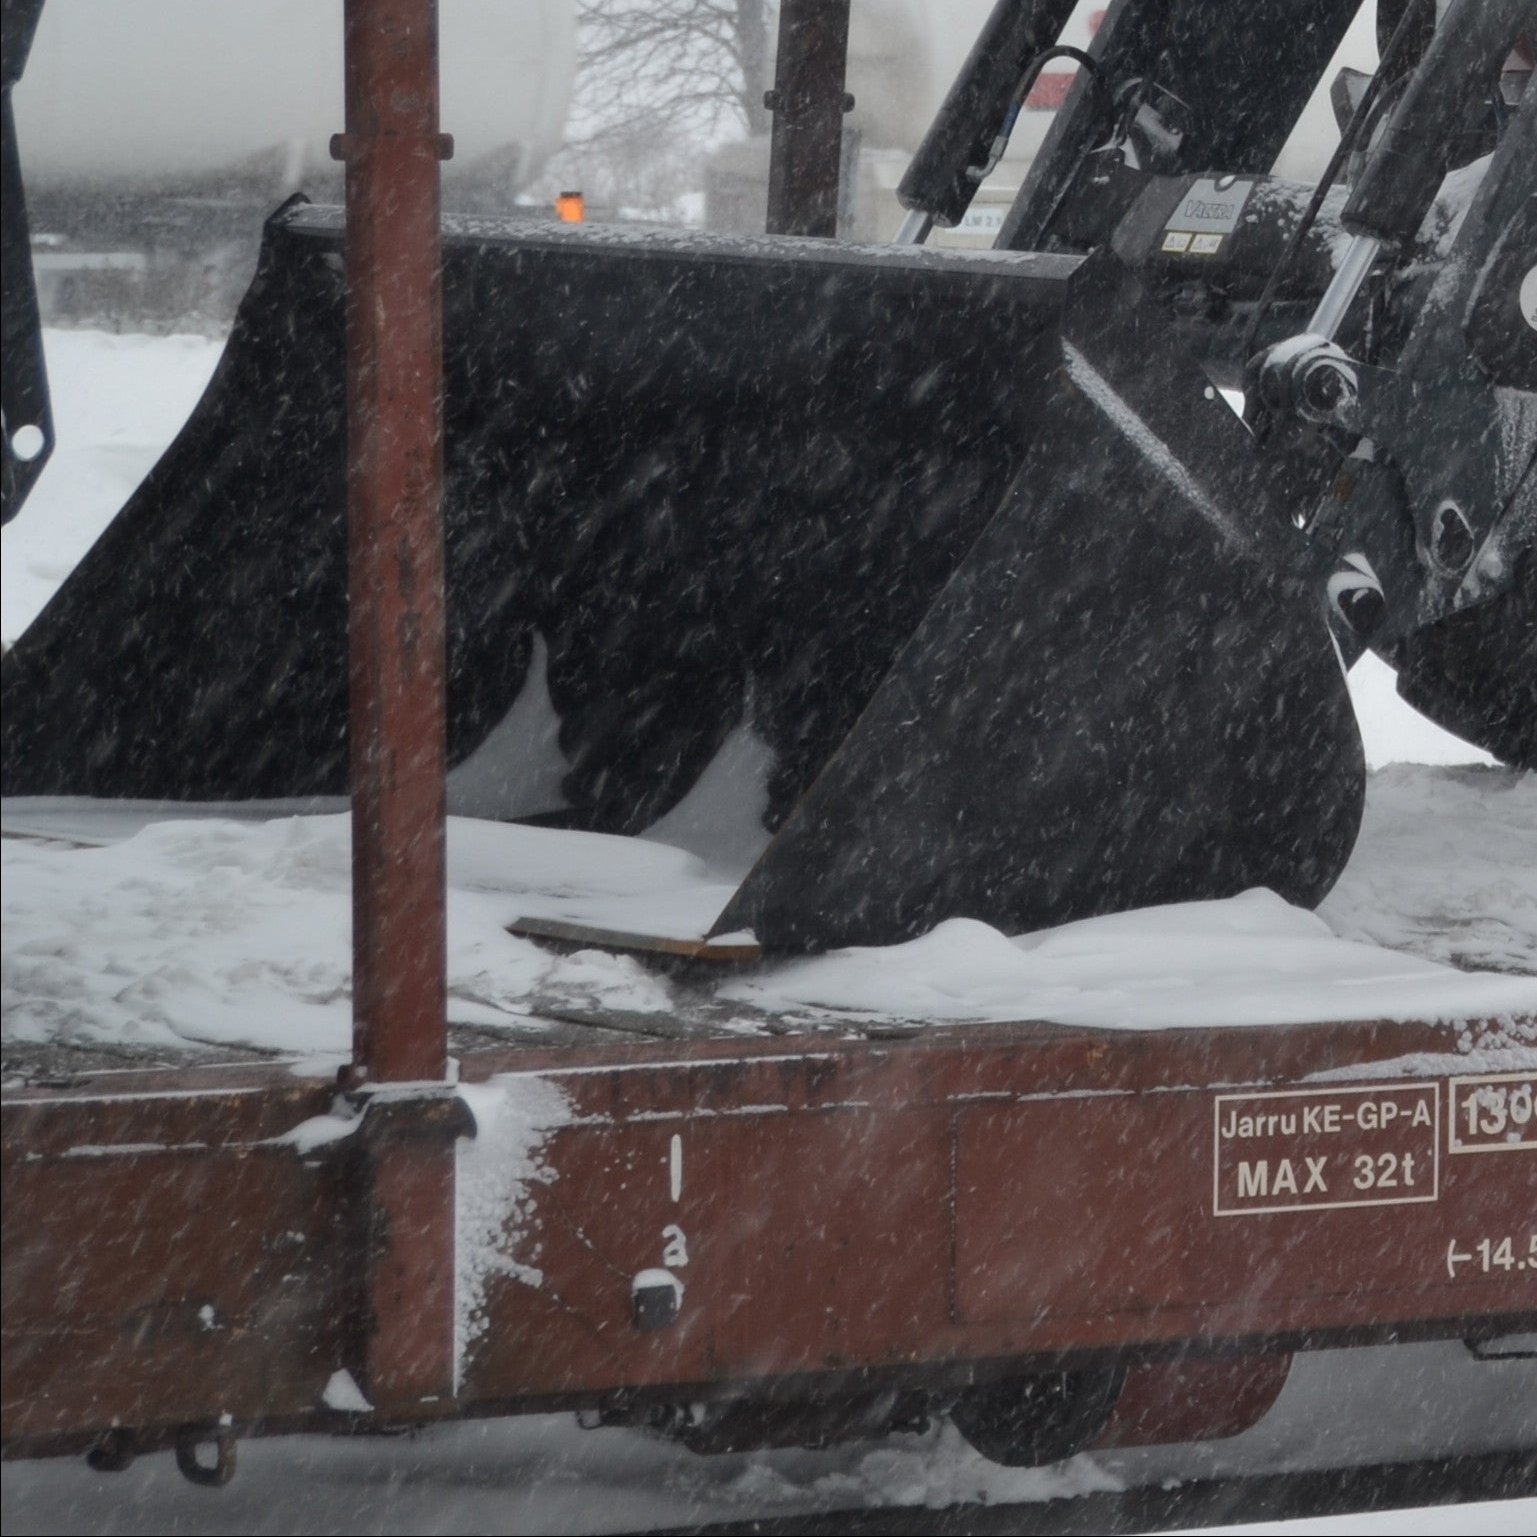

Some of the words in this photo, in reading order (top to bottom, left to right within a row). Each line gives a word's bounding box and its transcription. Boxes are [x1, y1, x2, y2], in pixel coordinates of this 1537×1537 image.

[1221, 1111, 1297, 1140] Jarru
[1303, 1099, 1432, 1134] KE-GP-A
[1237, 1156, 1328, 1198] MAX
[1352, 1152, 1415, 1190] 32t
